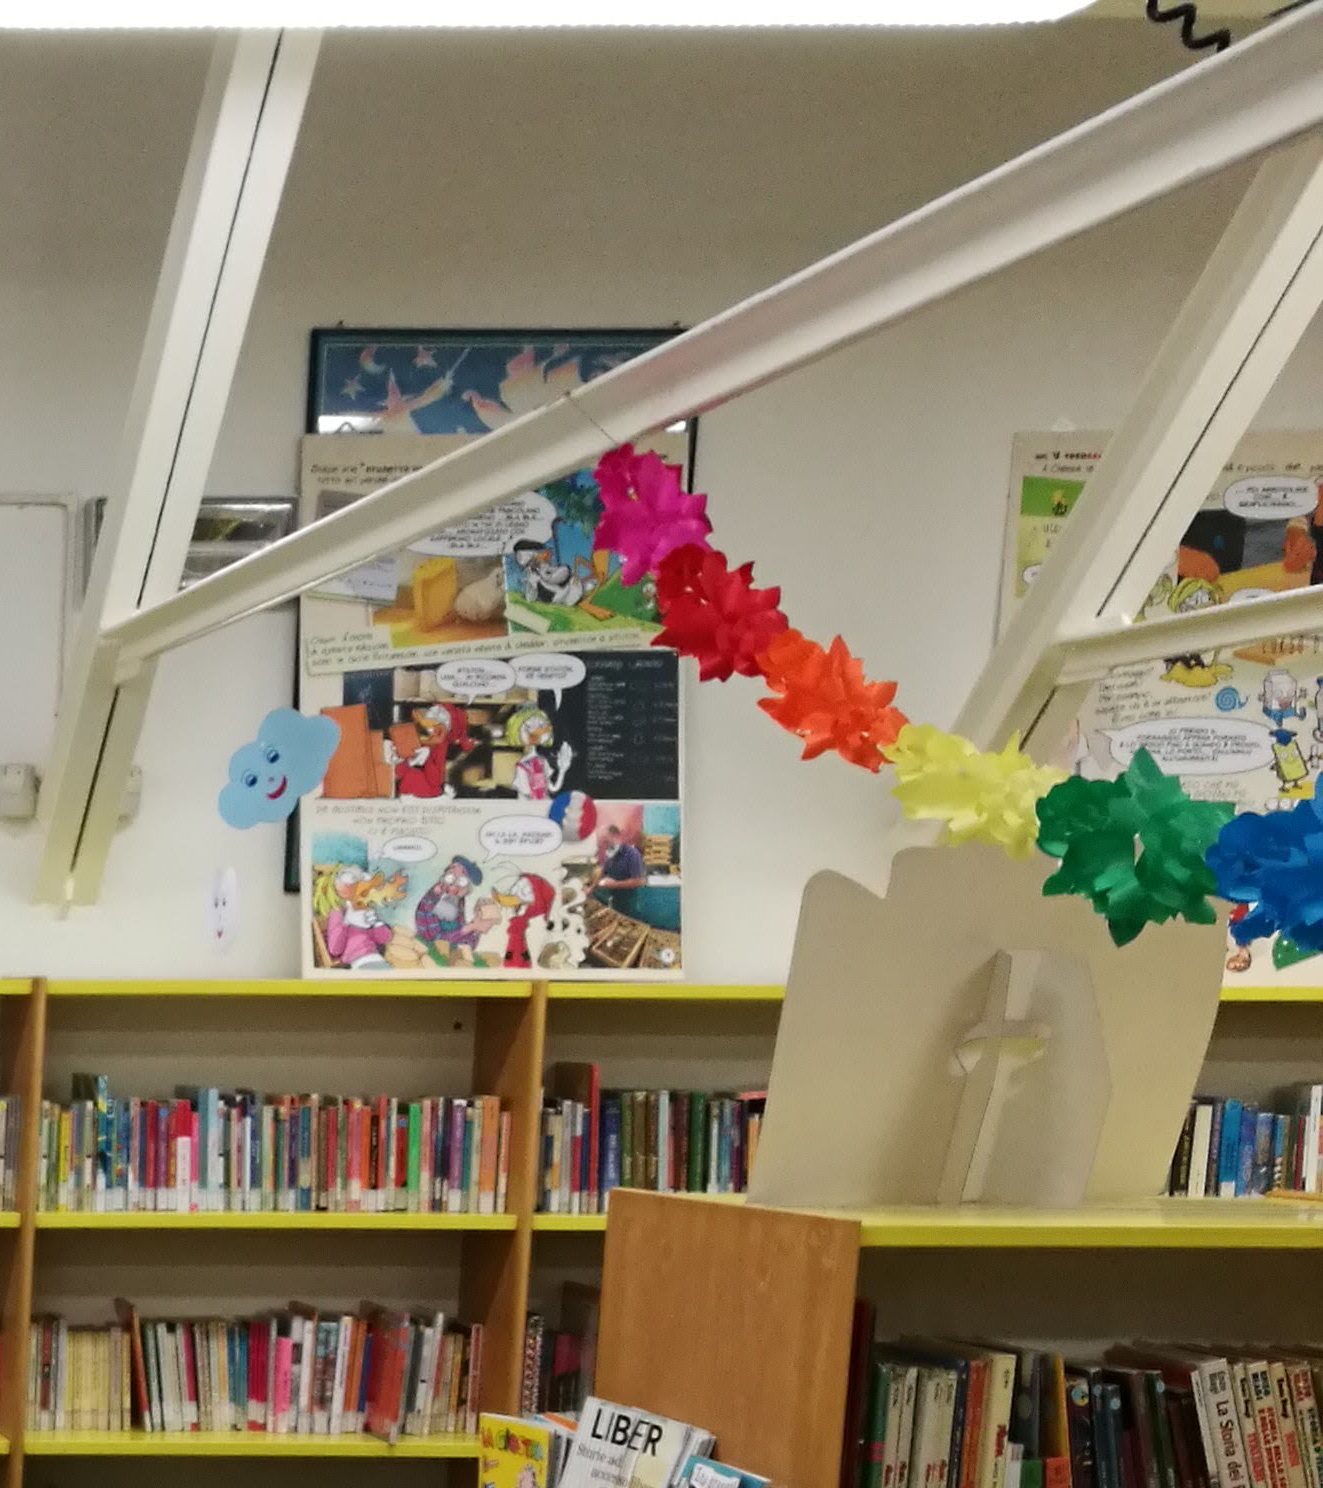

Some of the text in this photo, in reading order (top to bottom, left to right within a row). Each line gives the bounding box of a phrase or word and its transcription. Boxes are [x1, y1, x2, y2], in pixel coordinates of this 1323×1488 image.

[1216, 1400, 1229, 1418] La
[591, 1407, 664, 1457] LIBER
[1220, 1420, 1236, 1459] Storia
[1227, 1461, 1243, 1481] dei
